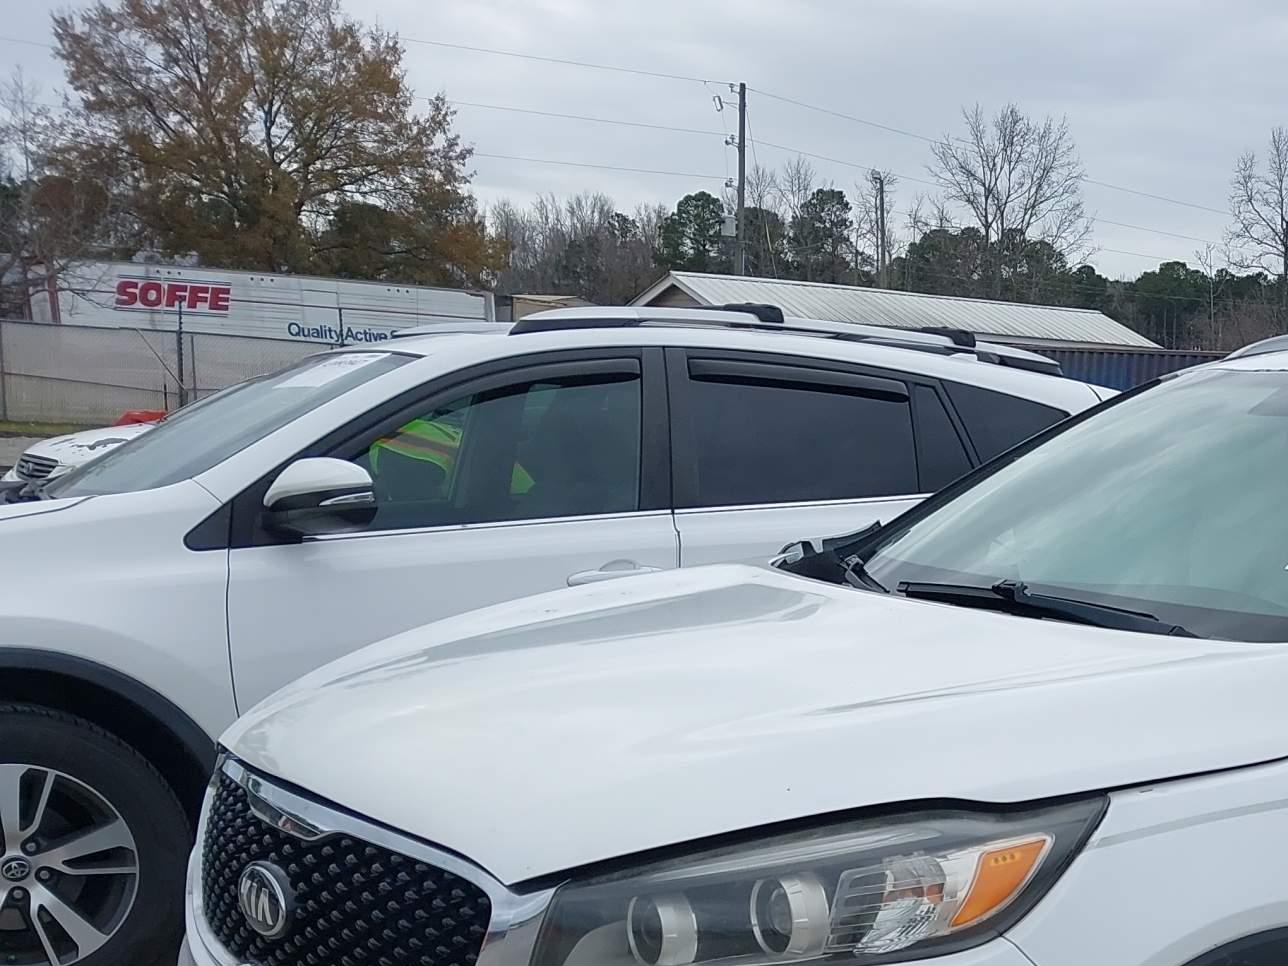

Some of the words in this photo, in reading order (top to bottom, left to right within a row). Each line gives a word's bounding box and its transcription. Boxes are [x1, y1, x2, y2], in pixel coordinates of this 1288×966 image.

[115, 280, 231, 311] SOFFE
[287, 322, 342, 342] Quality
[344, 327, 388, 342] Active
